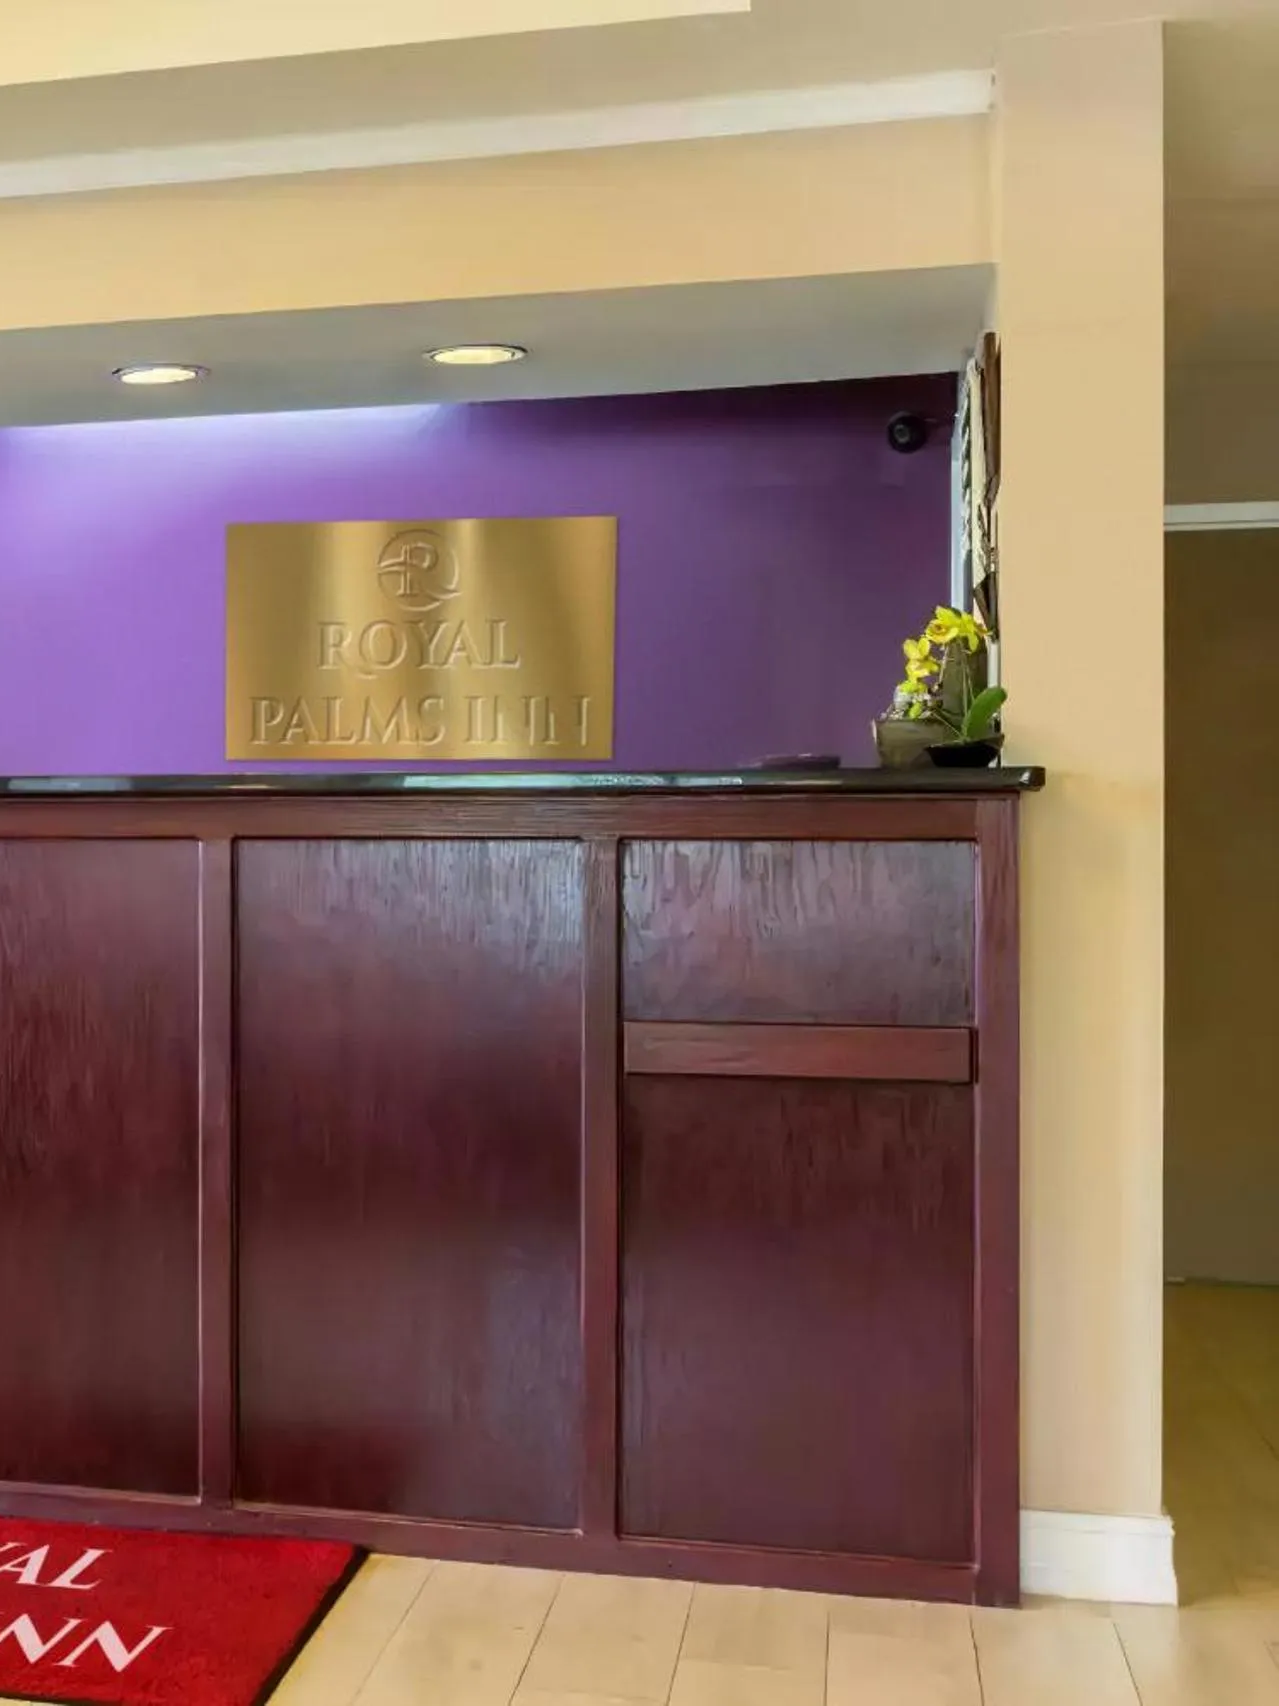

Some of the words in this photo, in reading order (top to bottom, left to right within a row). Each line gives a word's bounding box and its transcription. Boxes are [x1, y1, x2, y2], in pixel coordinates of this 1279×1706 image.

[317, 618, 522, 678] ROYAL
[249, 695, 445, 746] PALMS
[464, 695, 591, 746] INN
